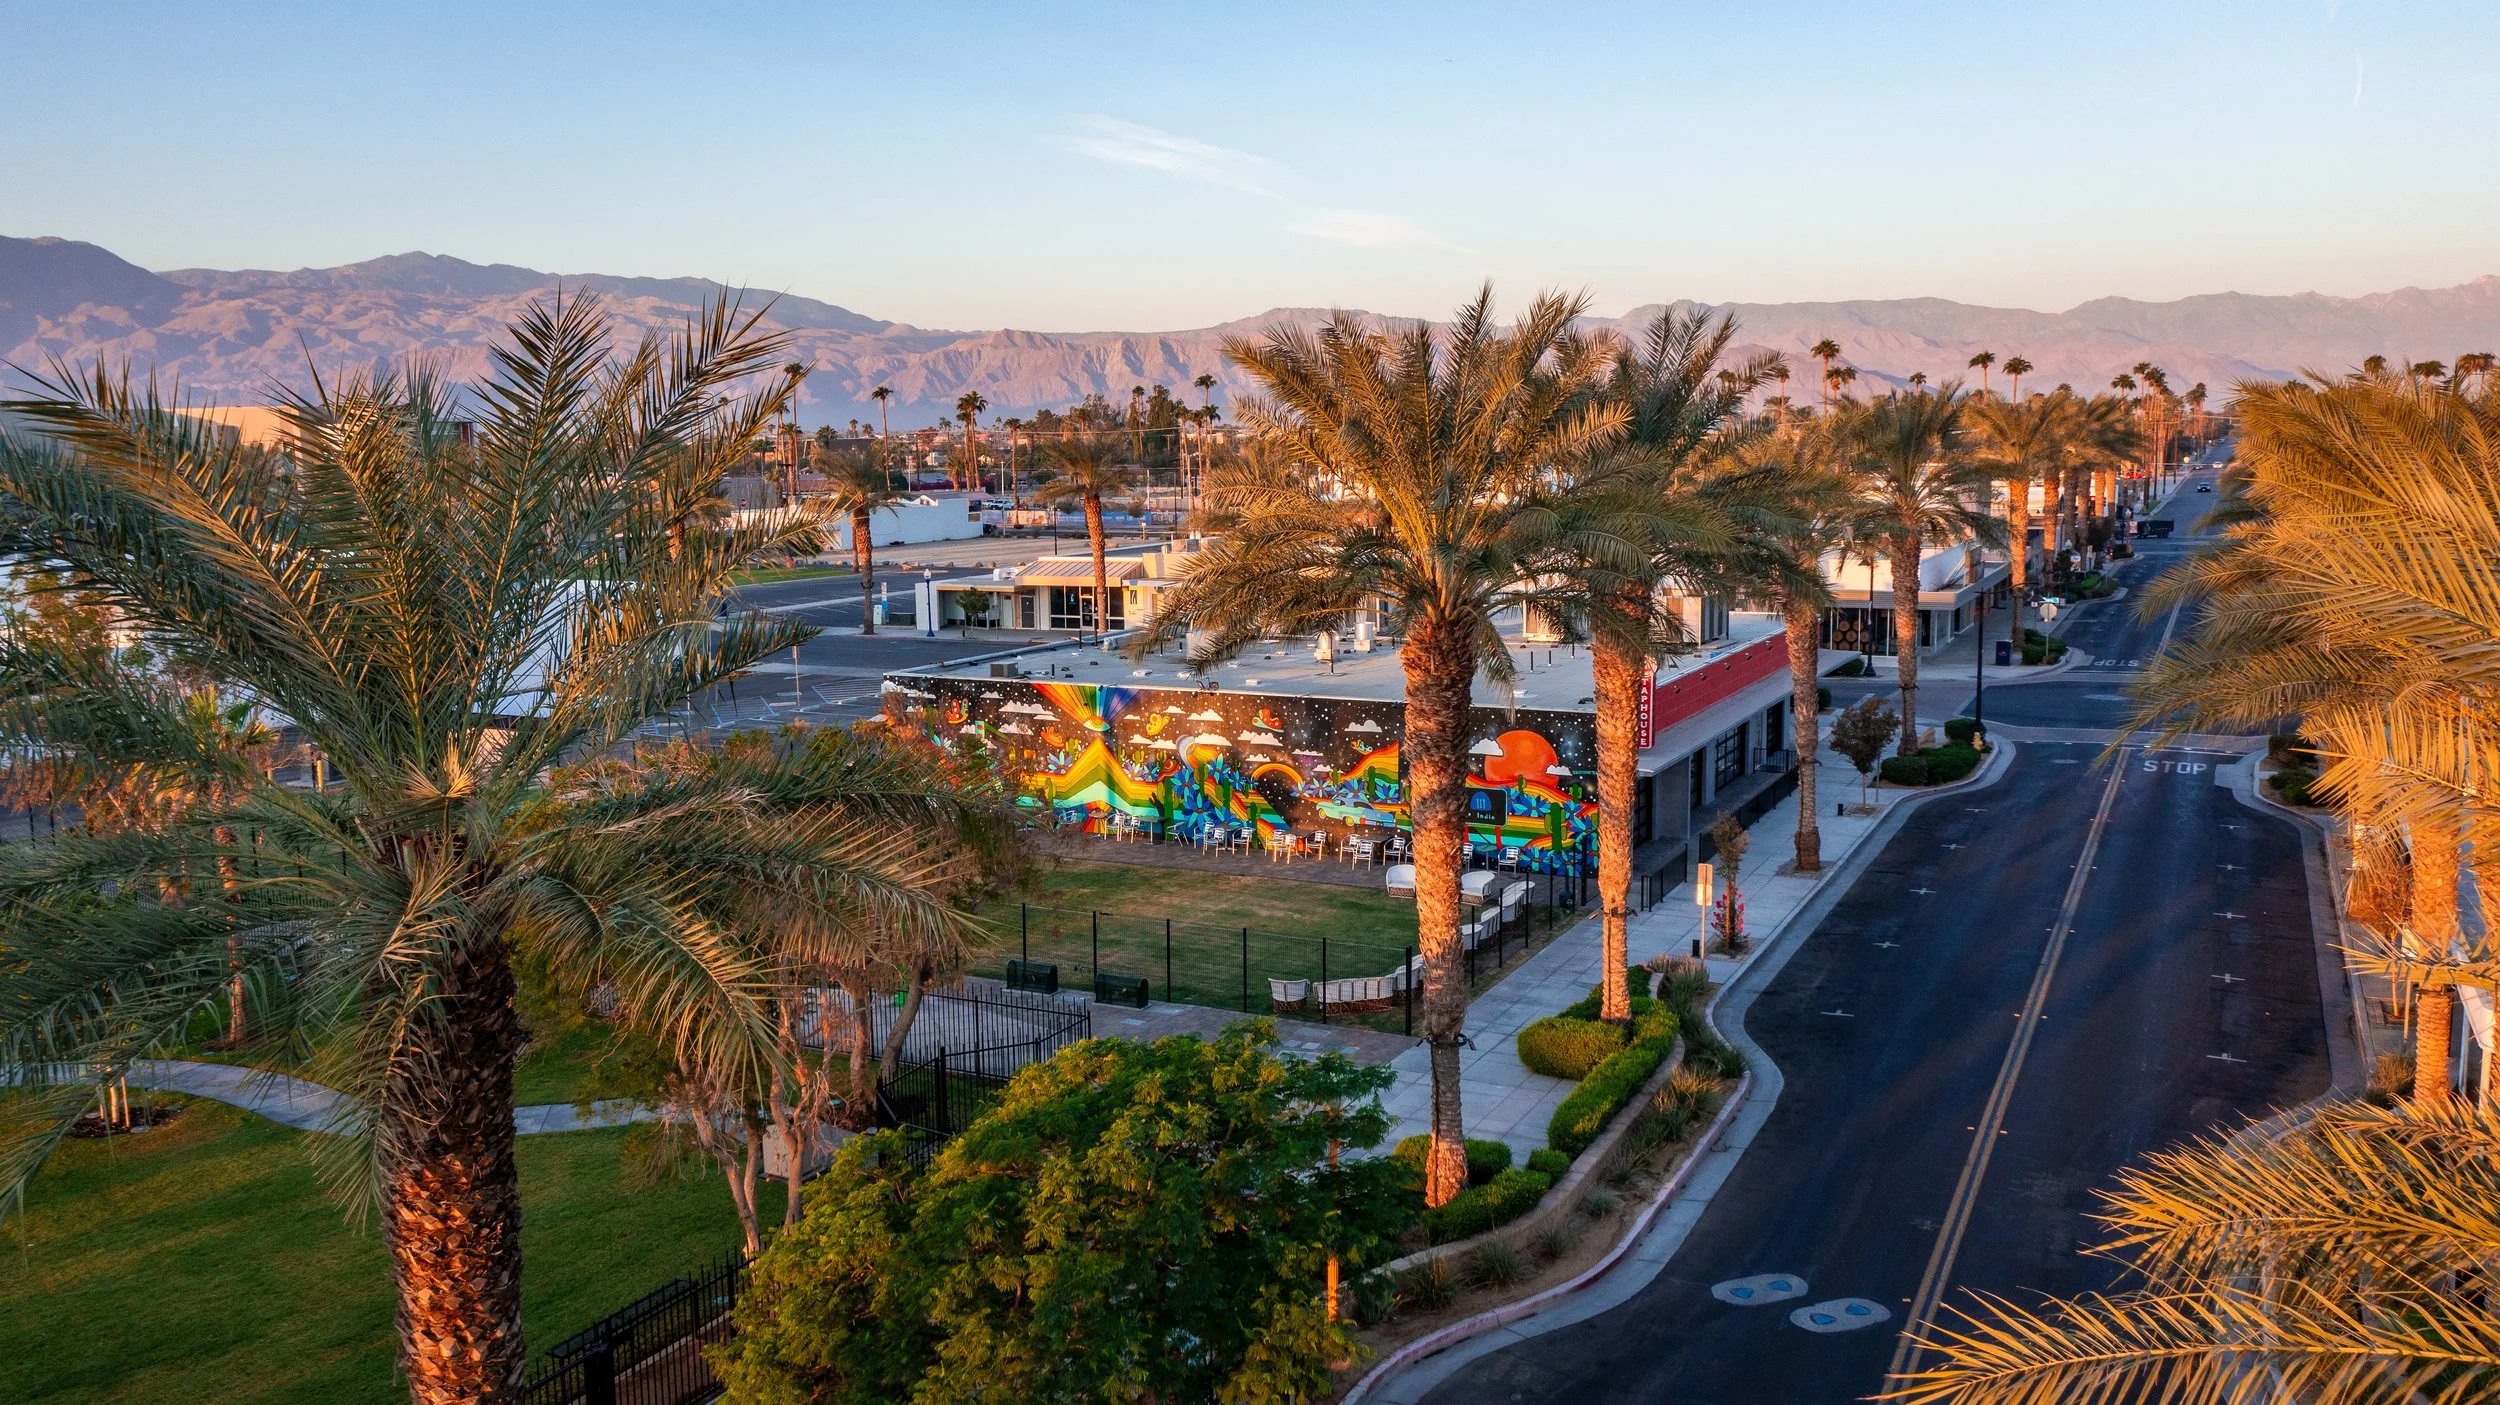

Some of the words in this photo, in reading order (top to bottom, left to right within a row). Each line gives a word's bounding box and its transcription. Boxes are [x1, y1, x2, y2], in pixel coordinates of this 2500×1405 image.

[2094, 659, 2140, 667] STOP
[1640, 678, 1649, 746] TAPHOUSE
[2143, 760, 2207, 775] STOP
[1476, 812, 1495, 820] Indio
